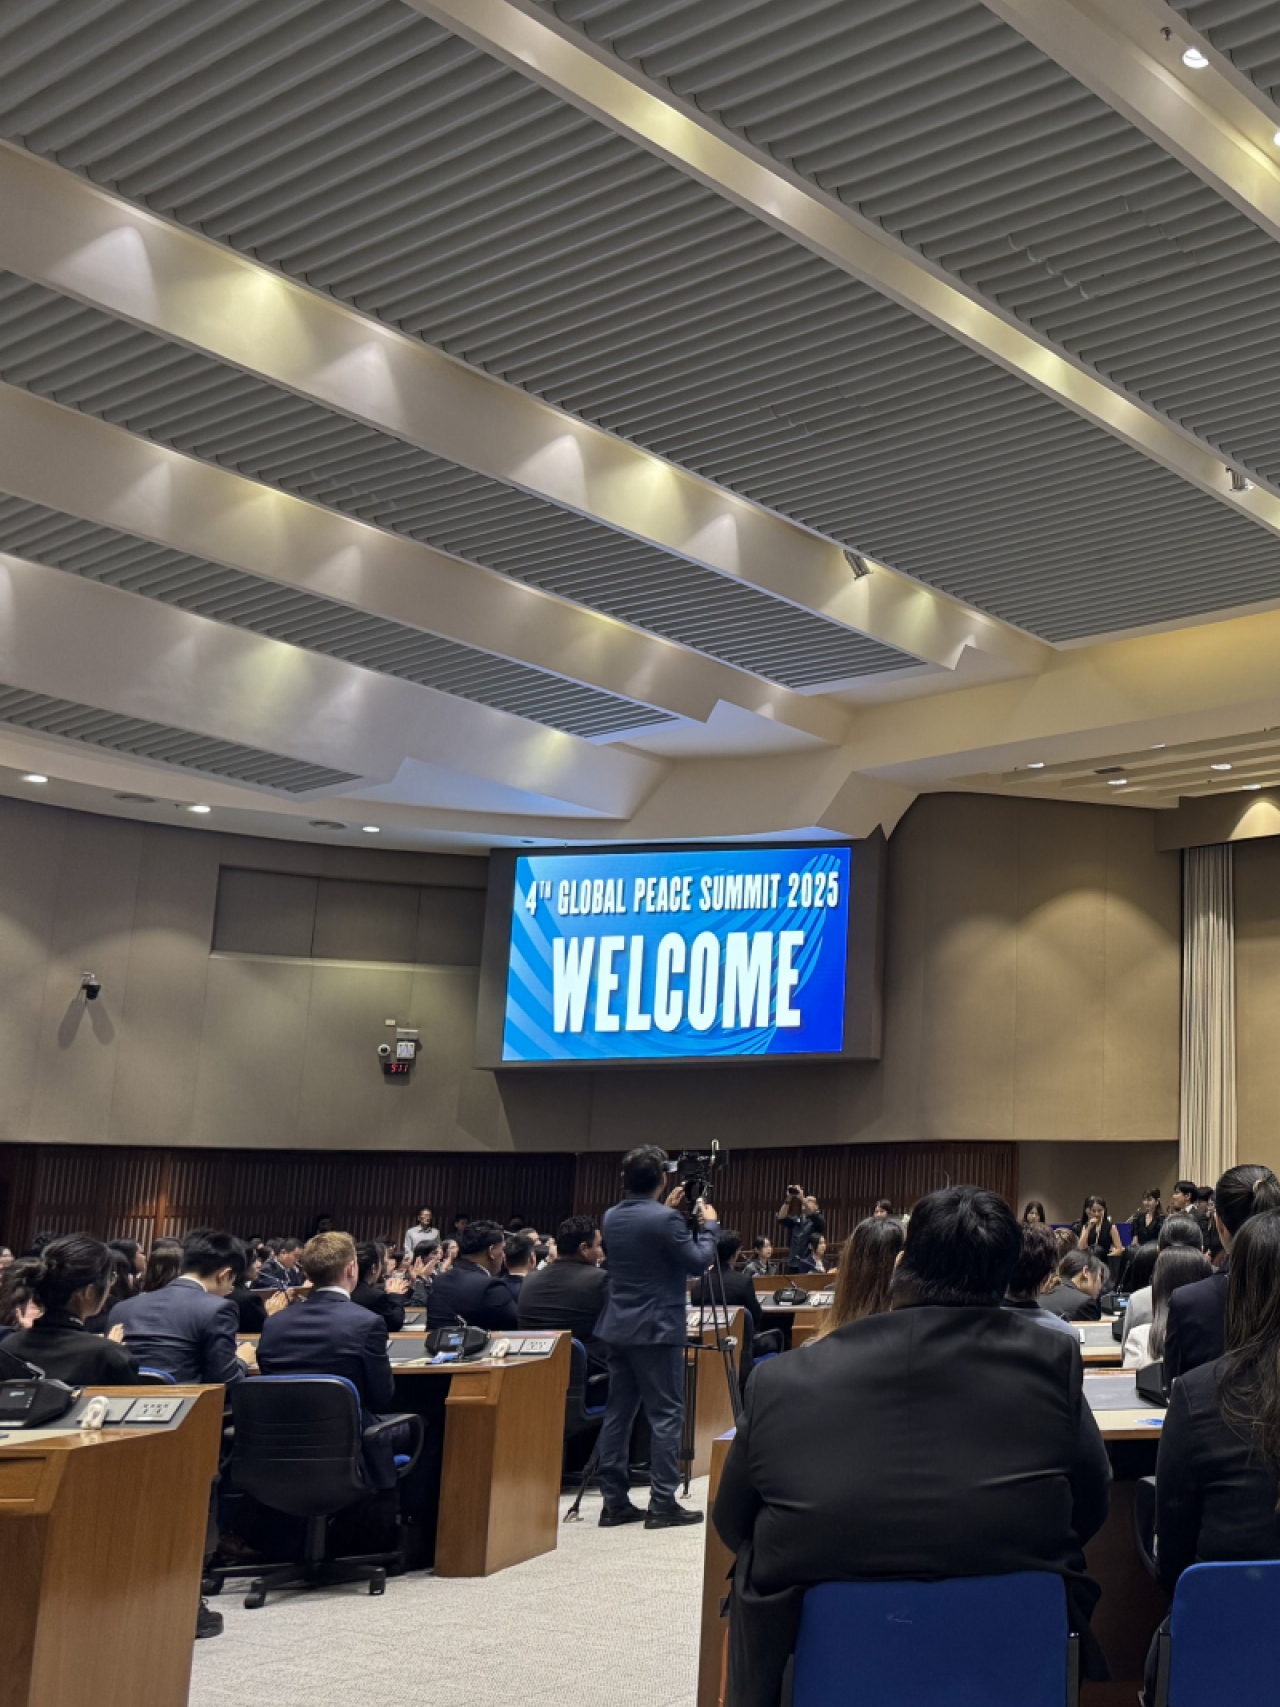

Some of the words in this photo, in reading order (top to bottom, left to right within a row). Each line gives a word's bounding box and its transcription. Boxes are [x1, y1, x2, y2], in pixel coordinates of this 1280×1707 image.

[525, 880, 553, 916] 4TH
[558, 878, 627, 916] GLOBAL
[633, 876, 694, 913] PEACE
[700, 873, 782, 912] SUMMIT
[787, 871, 840, 909] 2025
[552, 930, 805, 1034] WELCOME
